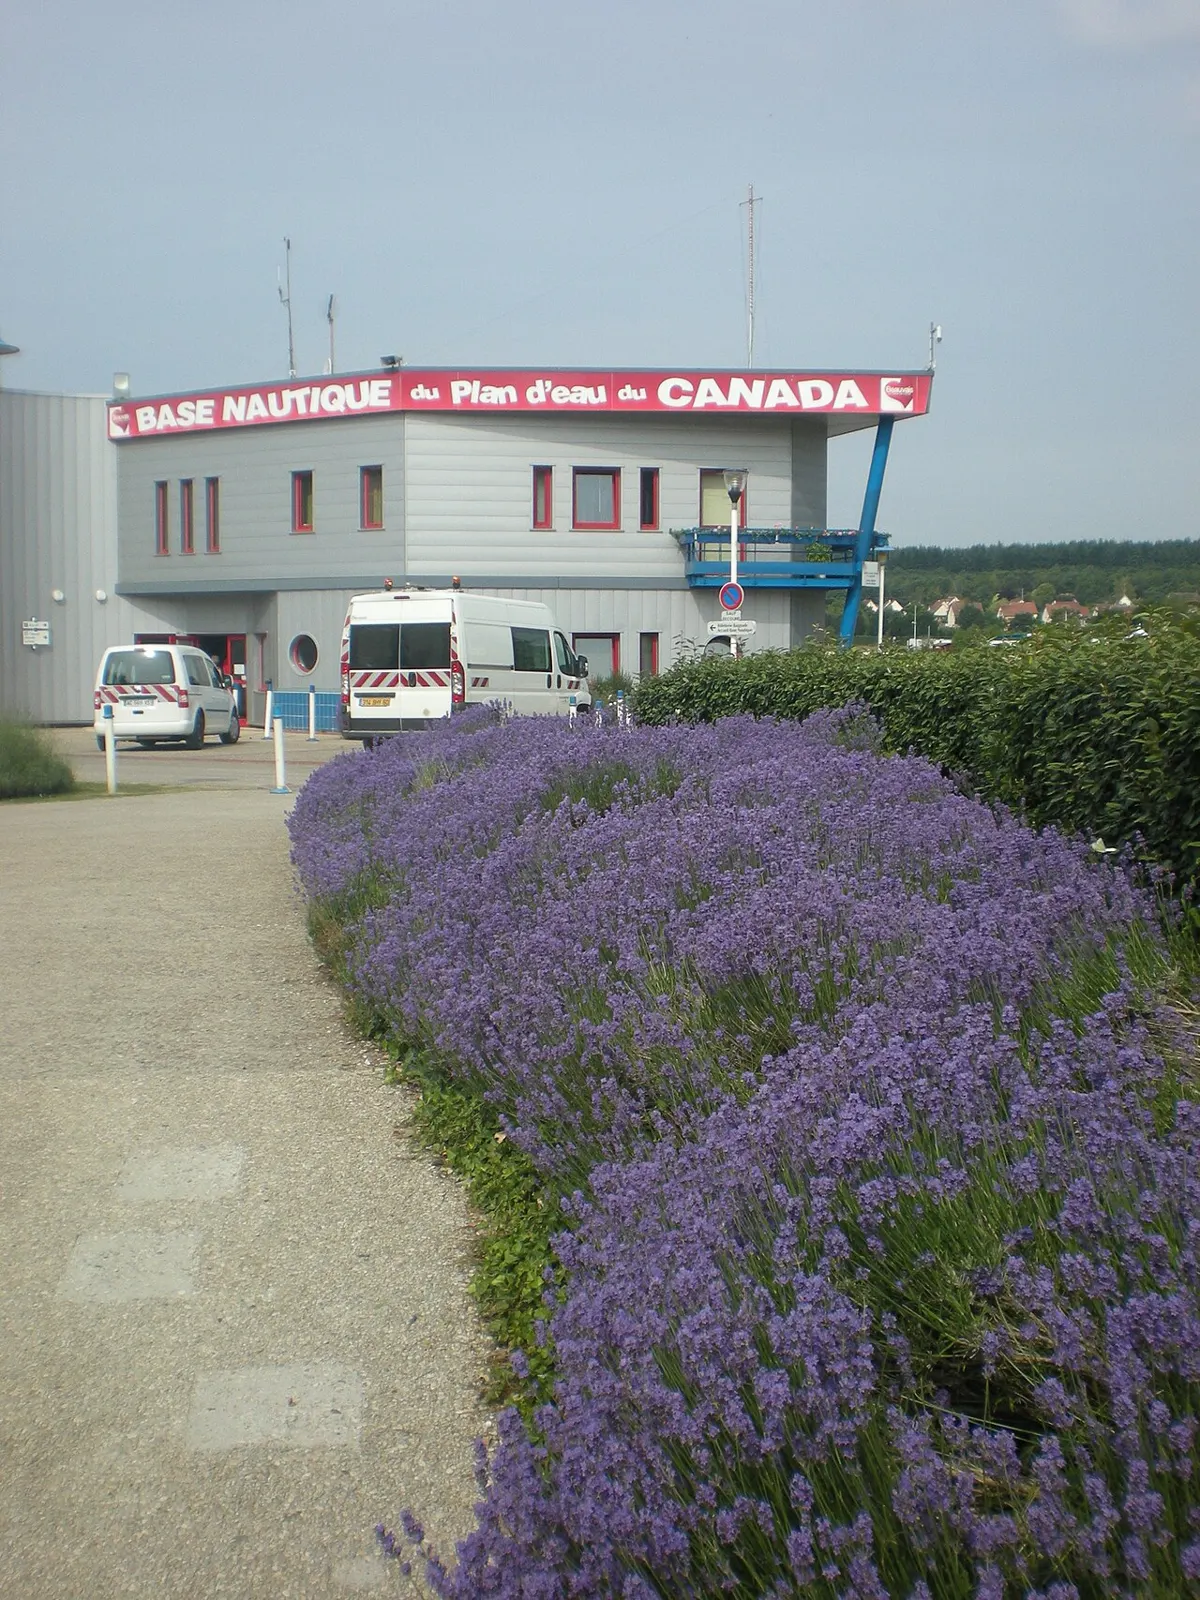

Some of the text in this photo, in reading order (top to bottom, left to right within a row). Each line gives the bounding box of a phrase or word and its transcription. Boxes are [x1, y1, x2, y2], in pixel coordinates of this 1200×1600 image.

[135, 376, 869, 433] BASE NAUTIQUE du Plan d'eau du CANADA
